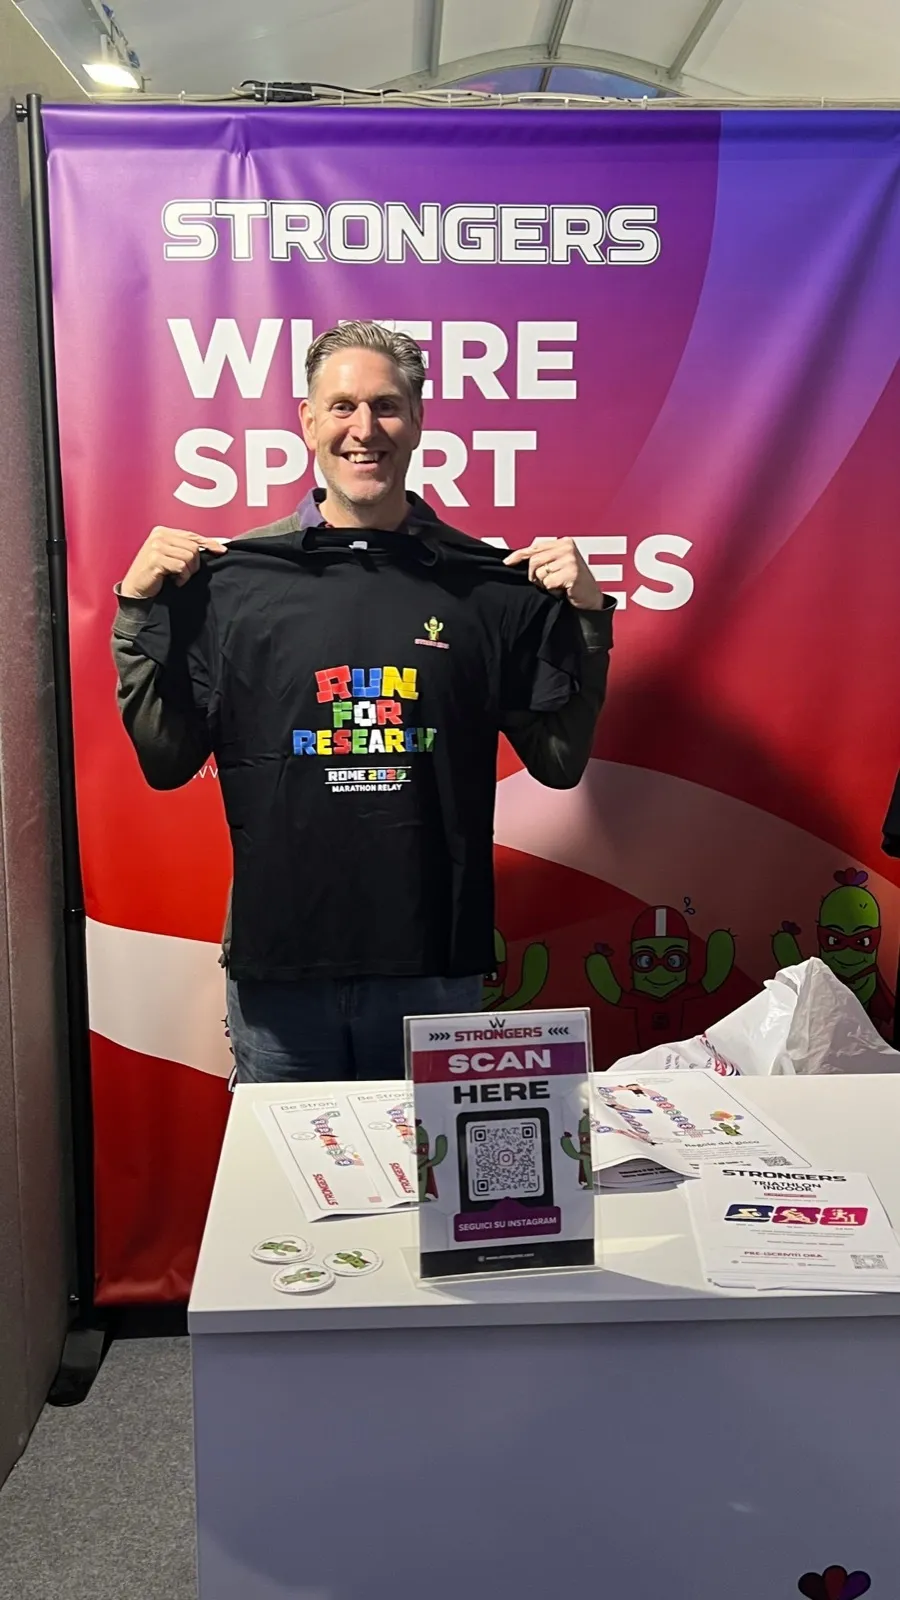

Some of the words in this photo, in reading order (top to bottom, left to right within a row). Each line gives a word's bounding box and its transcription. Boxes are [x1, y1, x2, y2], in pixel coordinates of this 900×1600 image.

[162, 199, 661, 265] STRONGERS
[167, 318, 578, 400] WRE
[173, 428, 538, 508] SPRT
[314, 665, 419, 703] RUN
[332, 699, 403, 728] FOR
[292, 728, 437, 756] RESEARCH
[328, 770, 366, 782] ROME
[332, 784, 376, 793] MARATHON
[377, 783, 402, 792] RELAY
[454, 1027, 543, 1042] STRONGERS
[448, 1049, 551, 1074] SCAN
[453, 1080, 550, 1105] HERE
[722, 1169, 847, 1182] STRONGERS
[752, 1180, 822, 1189] TRIATHLON
[762, 1185, 813, 1193] INDOOR
[458, 1221, 493, 1232] SEGUICI
[494, 1220, 506, 1229] SU
[507, 1216, 557, 1228] INSTAGRAM
